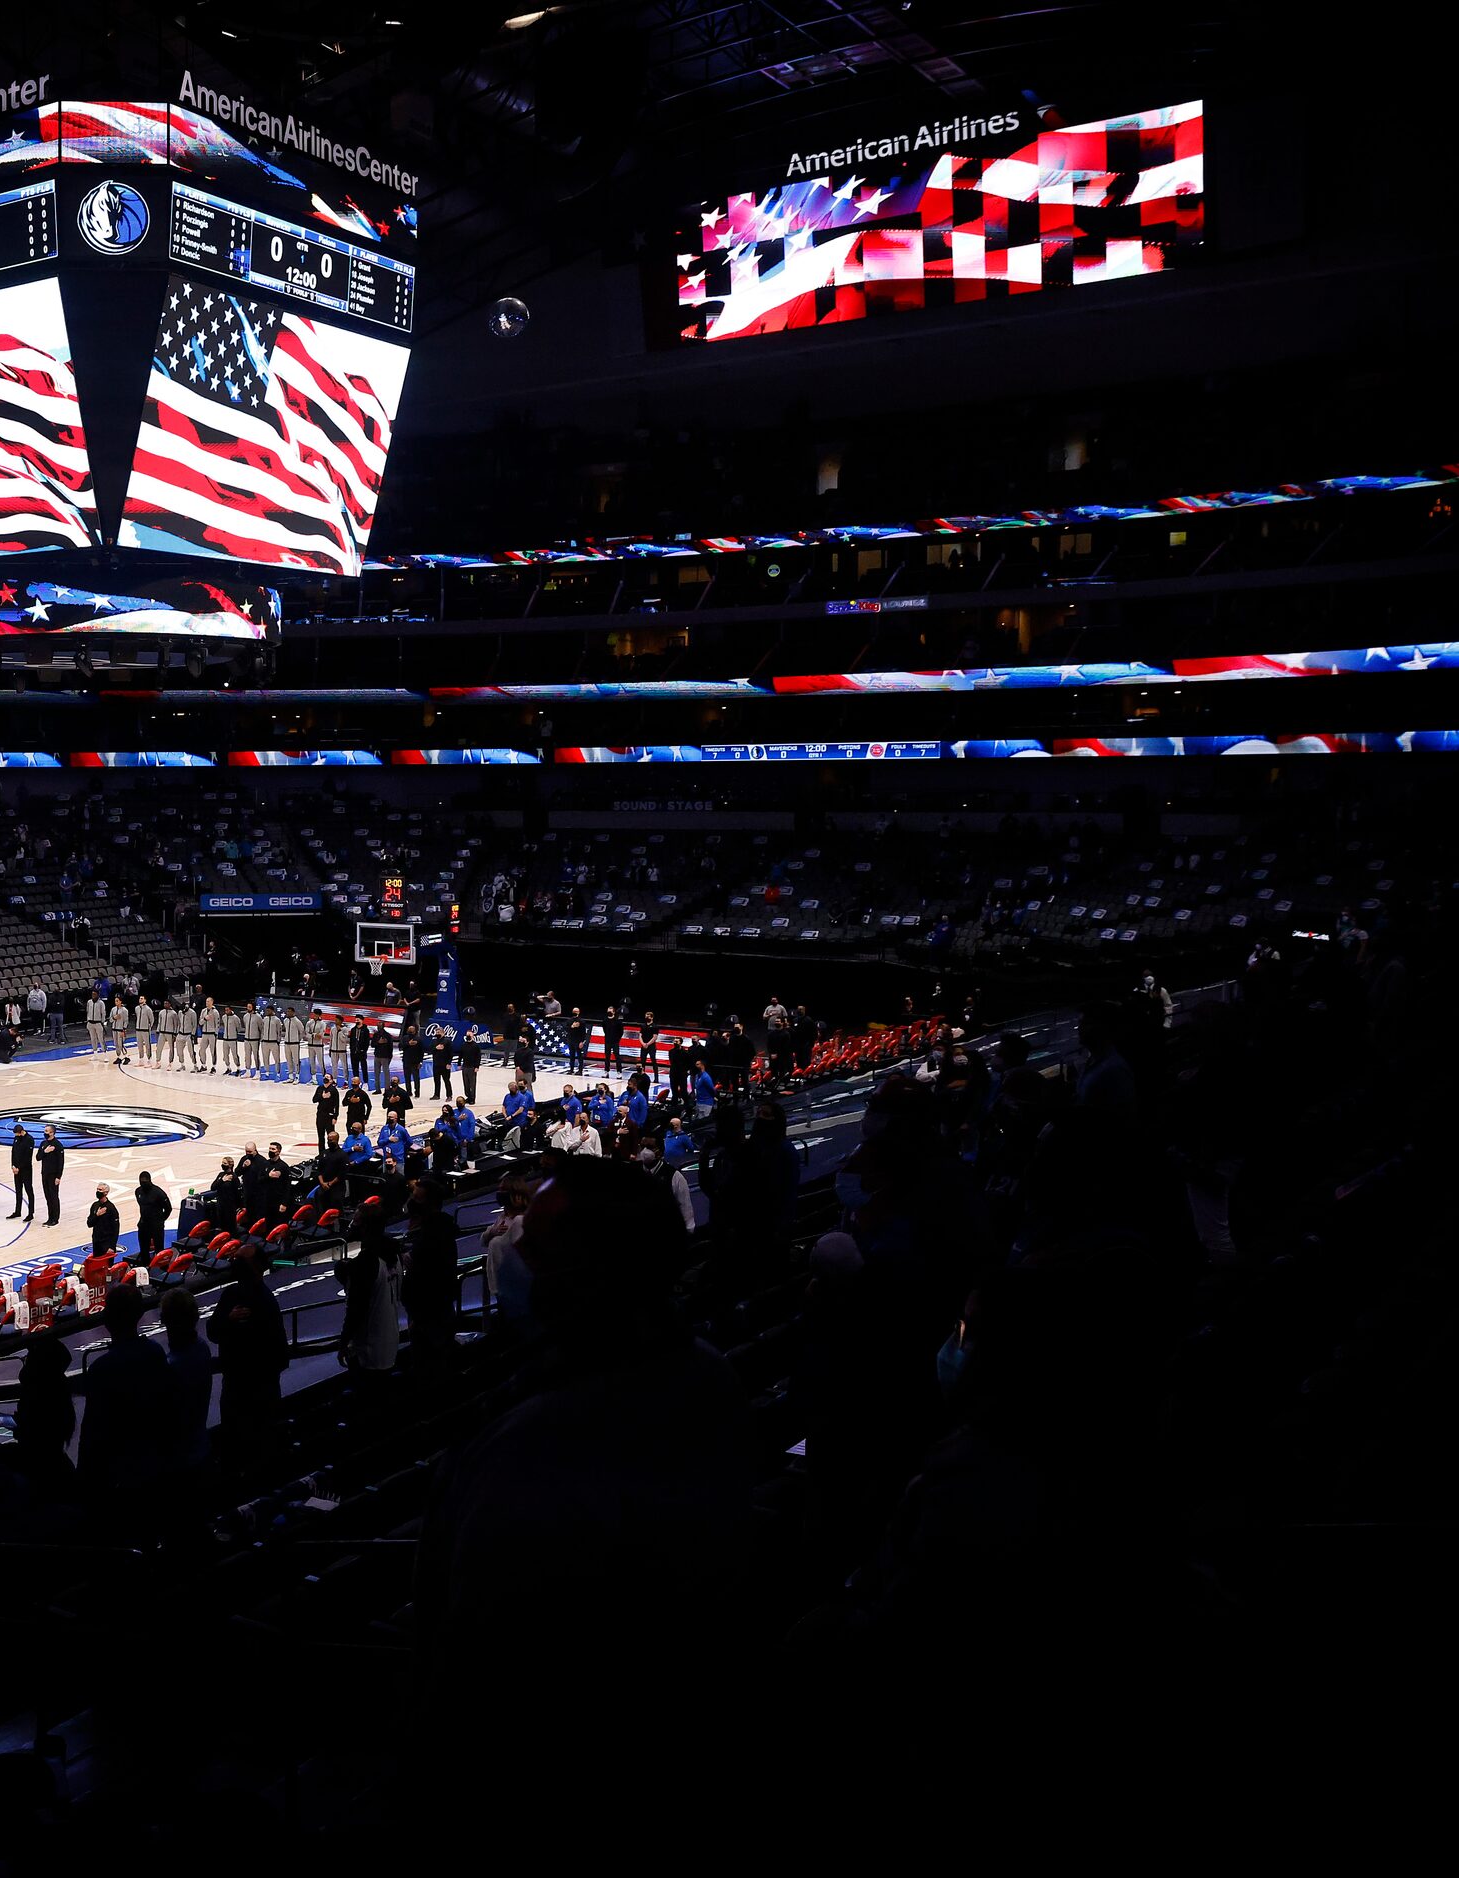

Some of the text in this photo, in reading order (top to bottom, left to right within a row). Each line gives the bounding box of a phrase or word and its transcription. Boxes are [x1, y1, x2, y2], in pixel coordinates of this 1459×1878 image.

[786, 111, 1020, 177] American Airlines
[28, 201, 32, 209] 0
[41, 198, 46, 206] 0
[176, 199, 214, 219] 0 Richardson
[28, 213, 33, 221] 0
[42, 210, 46, 218] 0
[182, 213, 208, 229] Porzingis
[42, 221, 47, 230] 0
[182, 224, 201, 238] Powell
[43, 233, 47, 241] 0
[43, 245, 48, 253] 0
[173, 234, 218, 255] 10 Finney-Smith
[271, 236, 283, 262] 0
[296, 242, 308, 252] QTR
[173, 245, 179, 253] 77
[181, 247, 201, 261] Doncic
[321, 253, 332, 278] 0
[358, 262, 371, 272] Grant
[286, 266, 317, 289] 12:00
[358, 273, 374, 284] Joseph
[357, 283, 376, 295] Jackson
[356, 293, 374, 305] Plumlee
[356, 303, 365, 314] Bey
[860, 600, 881, 614] King
[613, 801, 712, 810] SOUND STAGE
[386, 879, 402, 887] 12:00
[386, 888, 400, 901] 24
[210, 897, 254, 906] GEICO
[269, 897, 313, 906] GEICO
[425, 1023, 458, 1042] Blly
[88, 1286, 106, 1300] BIO
[31, 1305, 50, 1319] BIO
